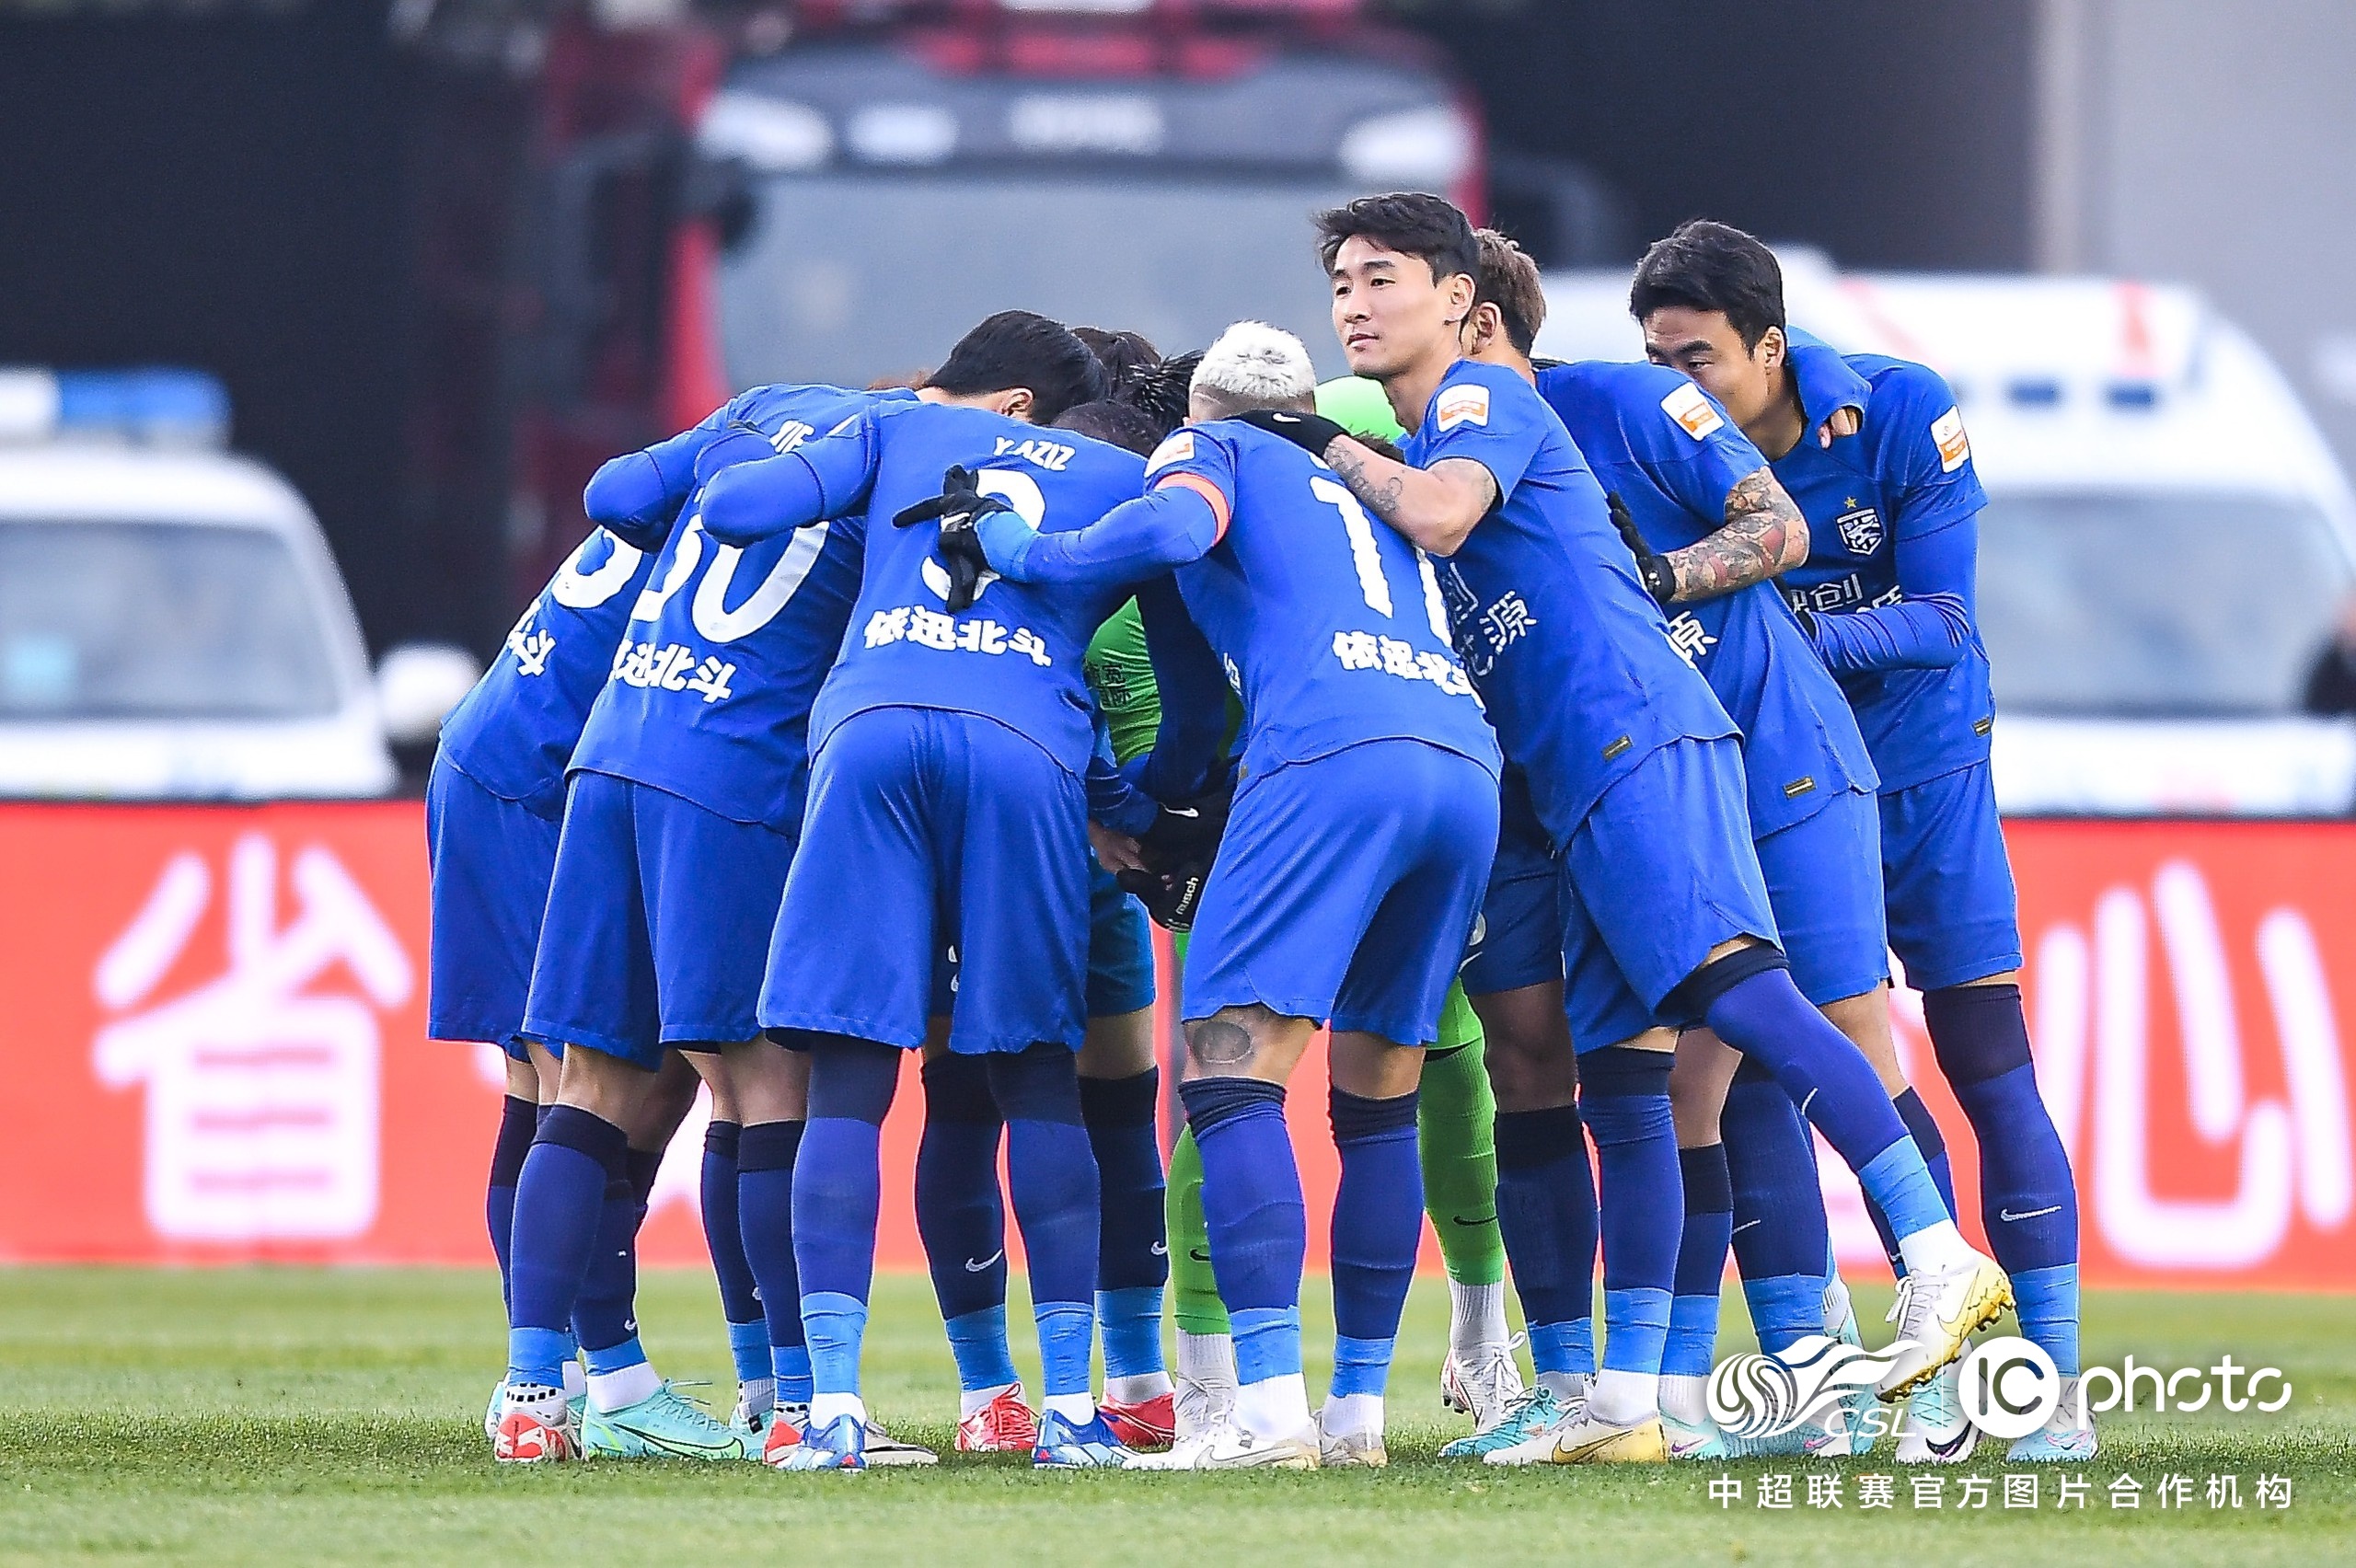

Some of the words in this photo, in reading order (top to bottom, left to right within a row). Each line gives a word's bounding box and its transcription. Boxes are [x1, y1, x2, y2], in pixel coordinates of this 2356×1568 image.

[863, 605, 1053, 667] 依迅北斗
[92, 832, 418, 1244] 省
